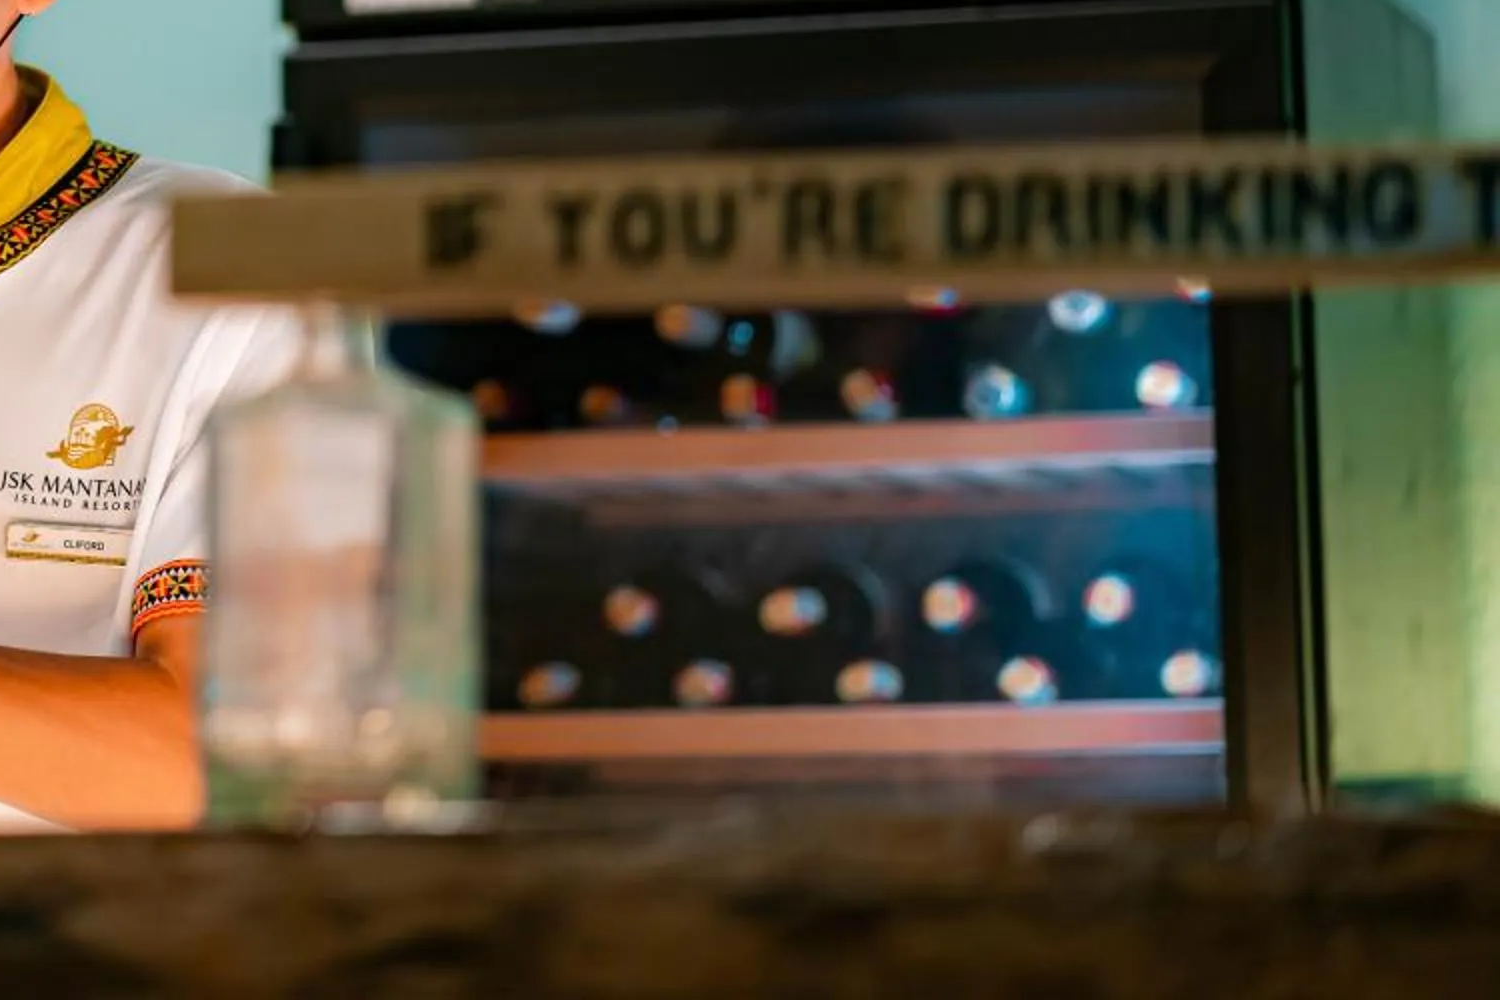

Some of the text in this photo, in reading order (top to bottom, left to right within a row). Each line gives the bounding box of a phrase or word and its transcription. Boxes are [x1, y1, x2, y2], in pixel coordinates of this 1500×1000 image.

[0, 471, 147, 498] JSK MANTANA
[13, 493, 72, 508] ISLAND
[63, 539, 105, 551] CLIFORD
